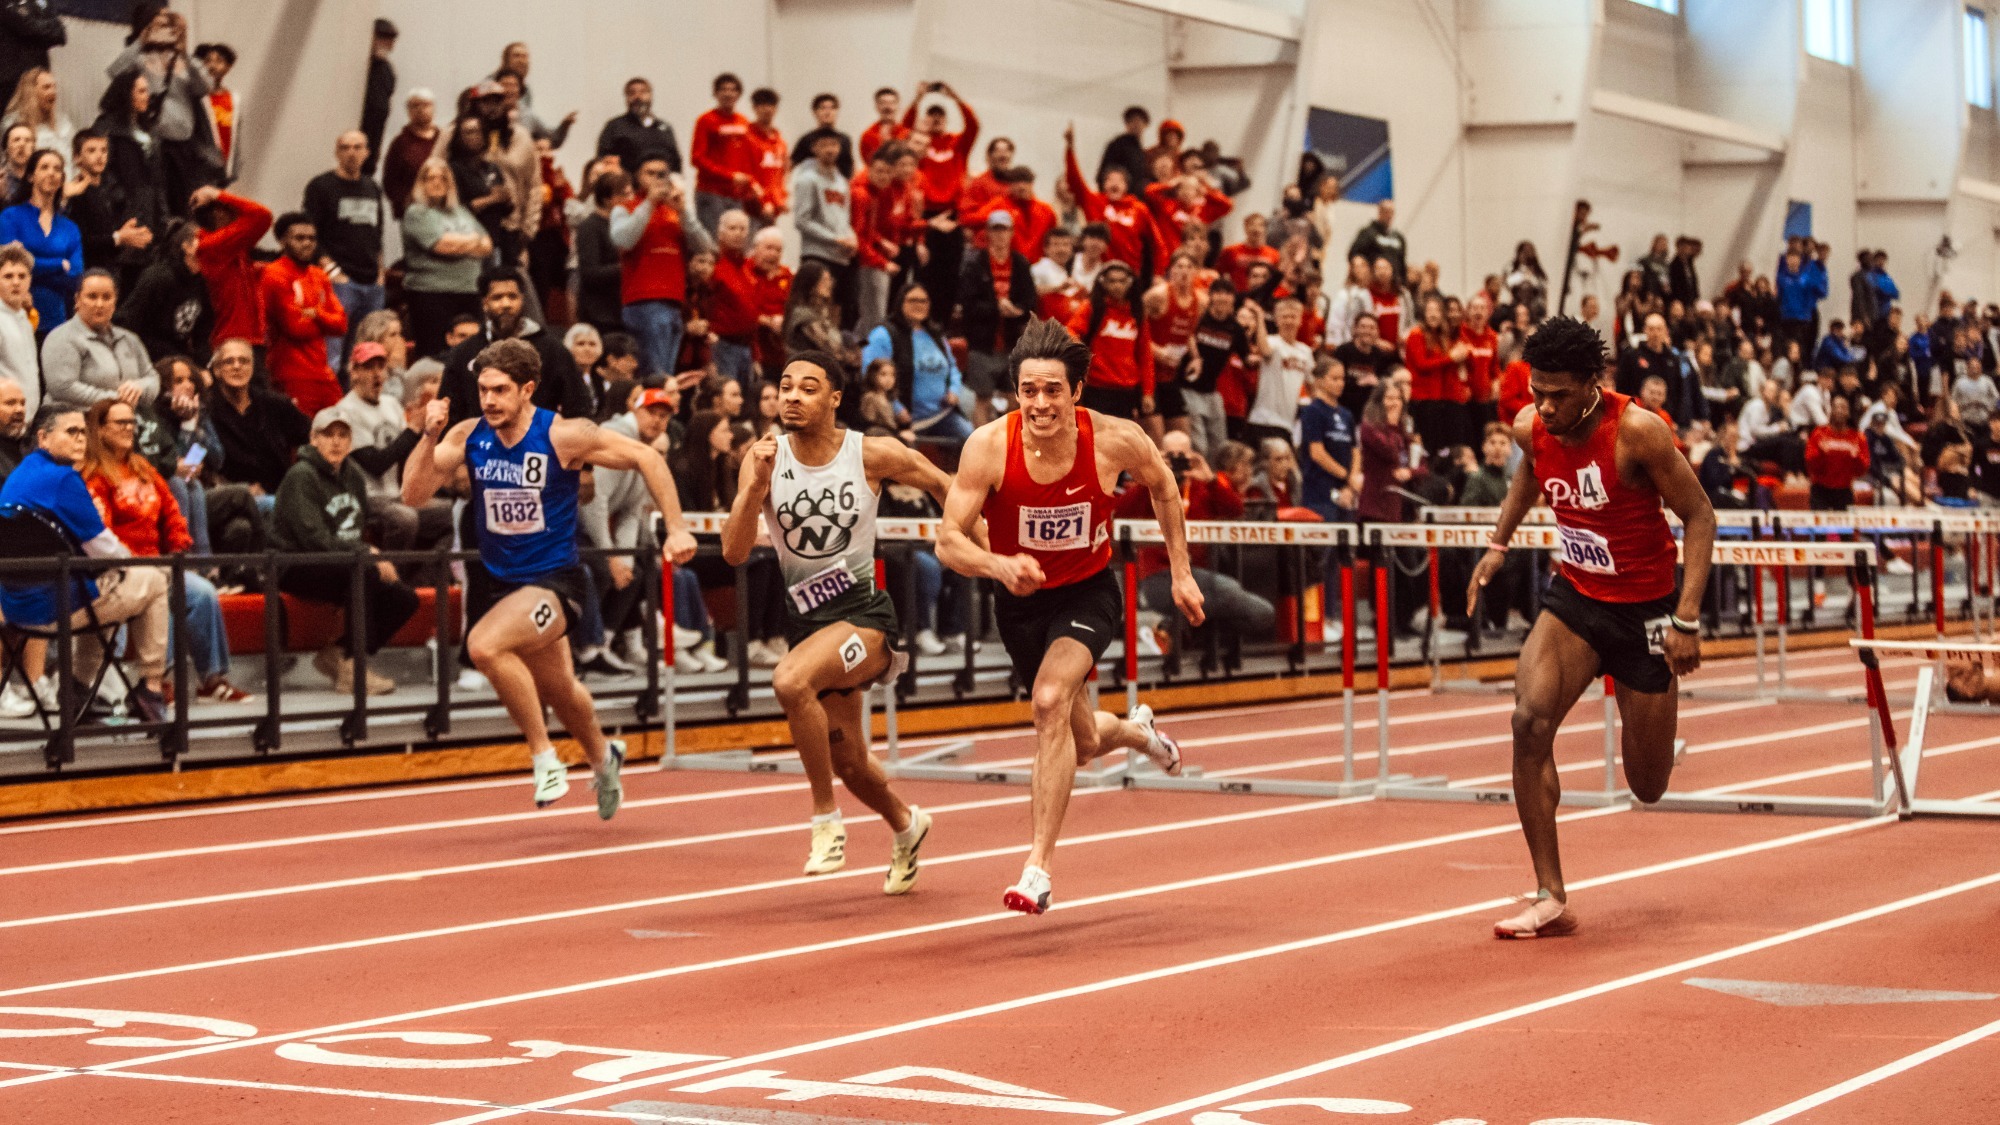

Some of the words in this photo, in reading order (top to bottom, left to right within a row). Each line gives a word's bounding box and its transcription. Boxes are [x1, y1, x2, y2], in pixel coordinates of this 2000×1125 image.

[526, 456, 542, 483] 8
[839, 481, 855, 511] 6
[1583, 473, 1598, 502] 4
[490, 502, 539, 522] 1832
[796, 526, 833, 551] N
[1025, 516, 1083, 541] 1621
[1189, 525, 1223, 540] PITT
[1229, 526, 1278, 542] STATE
[1443, 530, 1479, 544] PITT
[1562, 540, 1610, 567] 1946
[1732, 547, 1787, 563] STATE
[796, 571, 850, 609] 1896
[535, 603, 551, 628] 8
[844, 642, 863, 663] 6
